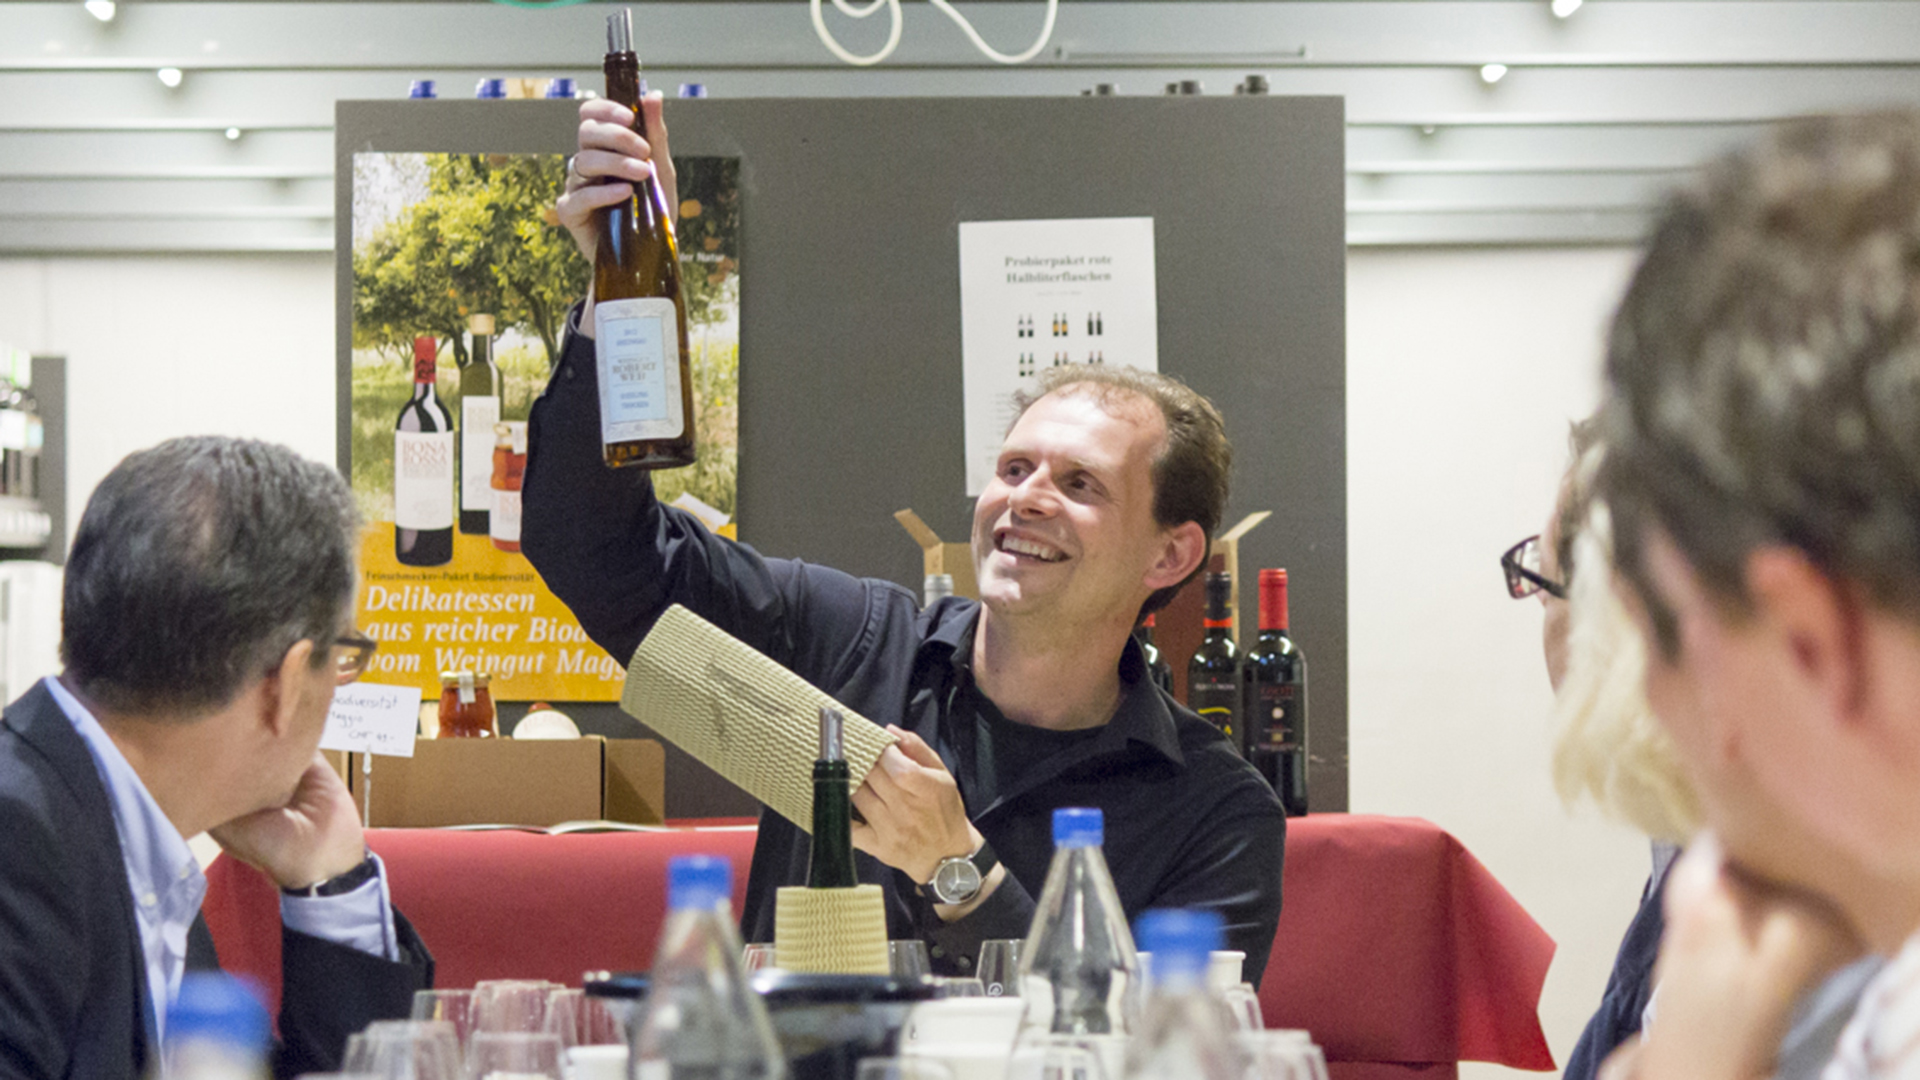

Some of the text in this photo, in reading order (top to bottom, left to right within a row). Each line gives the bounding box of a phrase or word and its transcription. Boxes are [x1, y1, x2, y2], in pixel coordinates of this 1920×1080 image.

[1004, 255, 1112, 268] Probierpaket rote
[1006, 271, 1112, 283] Halbliterflaschen
[366, 585, 535, 612] Delikatessen
[364, 622, 413, 642] aus
[424, 616, 519, 642] reicher
[366, 653, 421, 673] vom
[434, 647, 547, 680] Weingut
